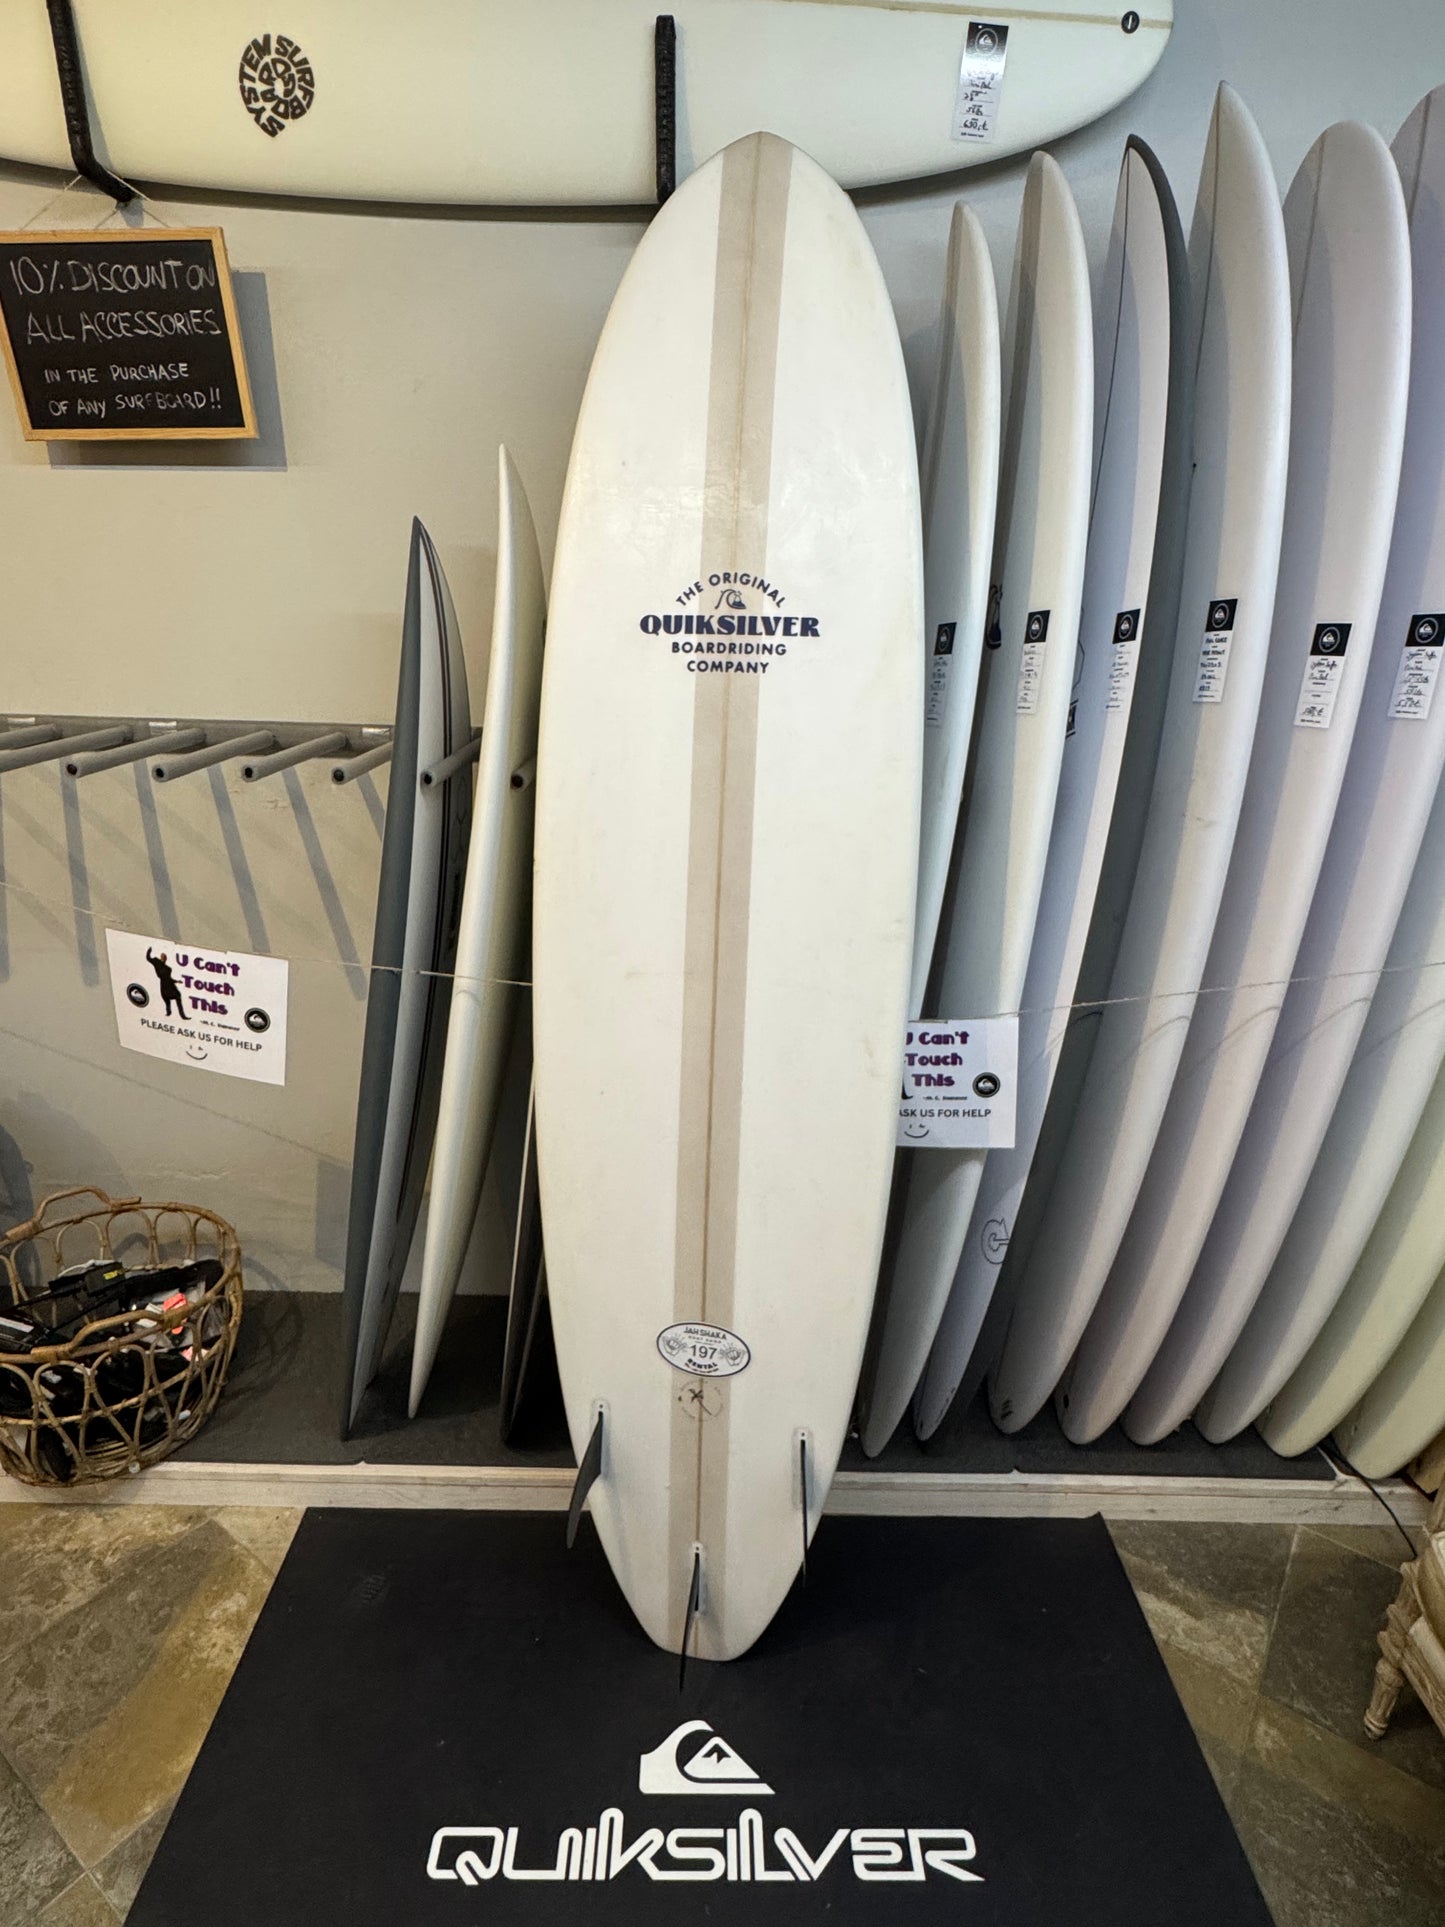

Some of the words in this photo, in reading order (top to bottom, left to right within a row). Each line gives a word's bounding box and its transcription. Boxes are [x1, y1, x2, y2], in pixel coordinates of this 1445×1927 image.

[10, 256, 64, 295] 10%
[67, 260, 183, 293] DISCOUNT
[186, 261, 215, 290] ON
[27, 312, 75, 345] ALL
[79, 309, 222, 343] ACCESSORIES
[44, 369, 61, 384] IN
[66, 367, 98, 384] THE
[109, 363, 189, 381] PURCHASE
[50, 400, 69, 416] OF
[77, 399, 106, 418] ANY
[675, 580, 704, 607] THE
[708, 571, 786, 608] ORIGINAL
[639, 614, 820, 637] QUIKSILVER
[671, 641, 787, 656] BOARDRIDING
[686, 660, 769, 674] COMPANY
[175, 953, 189, 967] U
[193, 956, 241, 977] Can't
[181, 974, 235, 996] Touch
[188, 996, 228, 1015] This
[140, 1018, 175, 1034] PLEASE
[177, 1027, 196, 1039] ASK
[198, 1031, 211, 1043] US
[213, 1035, 233, 1048] FOR
[236, 1039, 262, 1052] HELP
[918, 1031, 970, 1045] Can't
[904, 1052, 963, 1066] Touch
[911, 1073, 955, 1087] This
[920, 1108, 935, 1118] US
[937, 1108, 960, 1118] FOR
[962, 1109, 991, 1118] HELP
[690, 1344, 718, 1359] 197
[426, 1807, 985, 1885] QUIKSILVER
